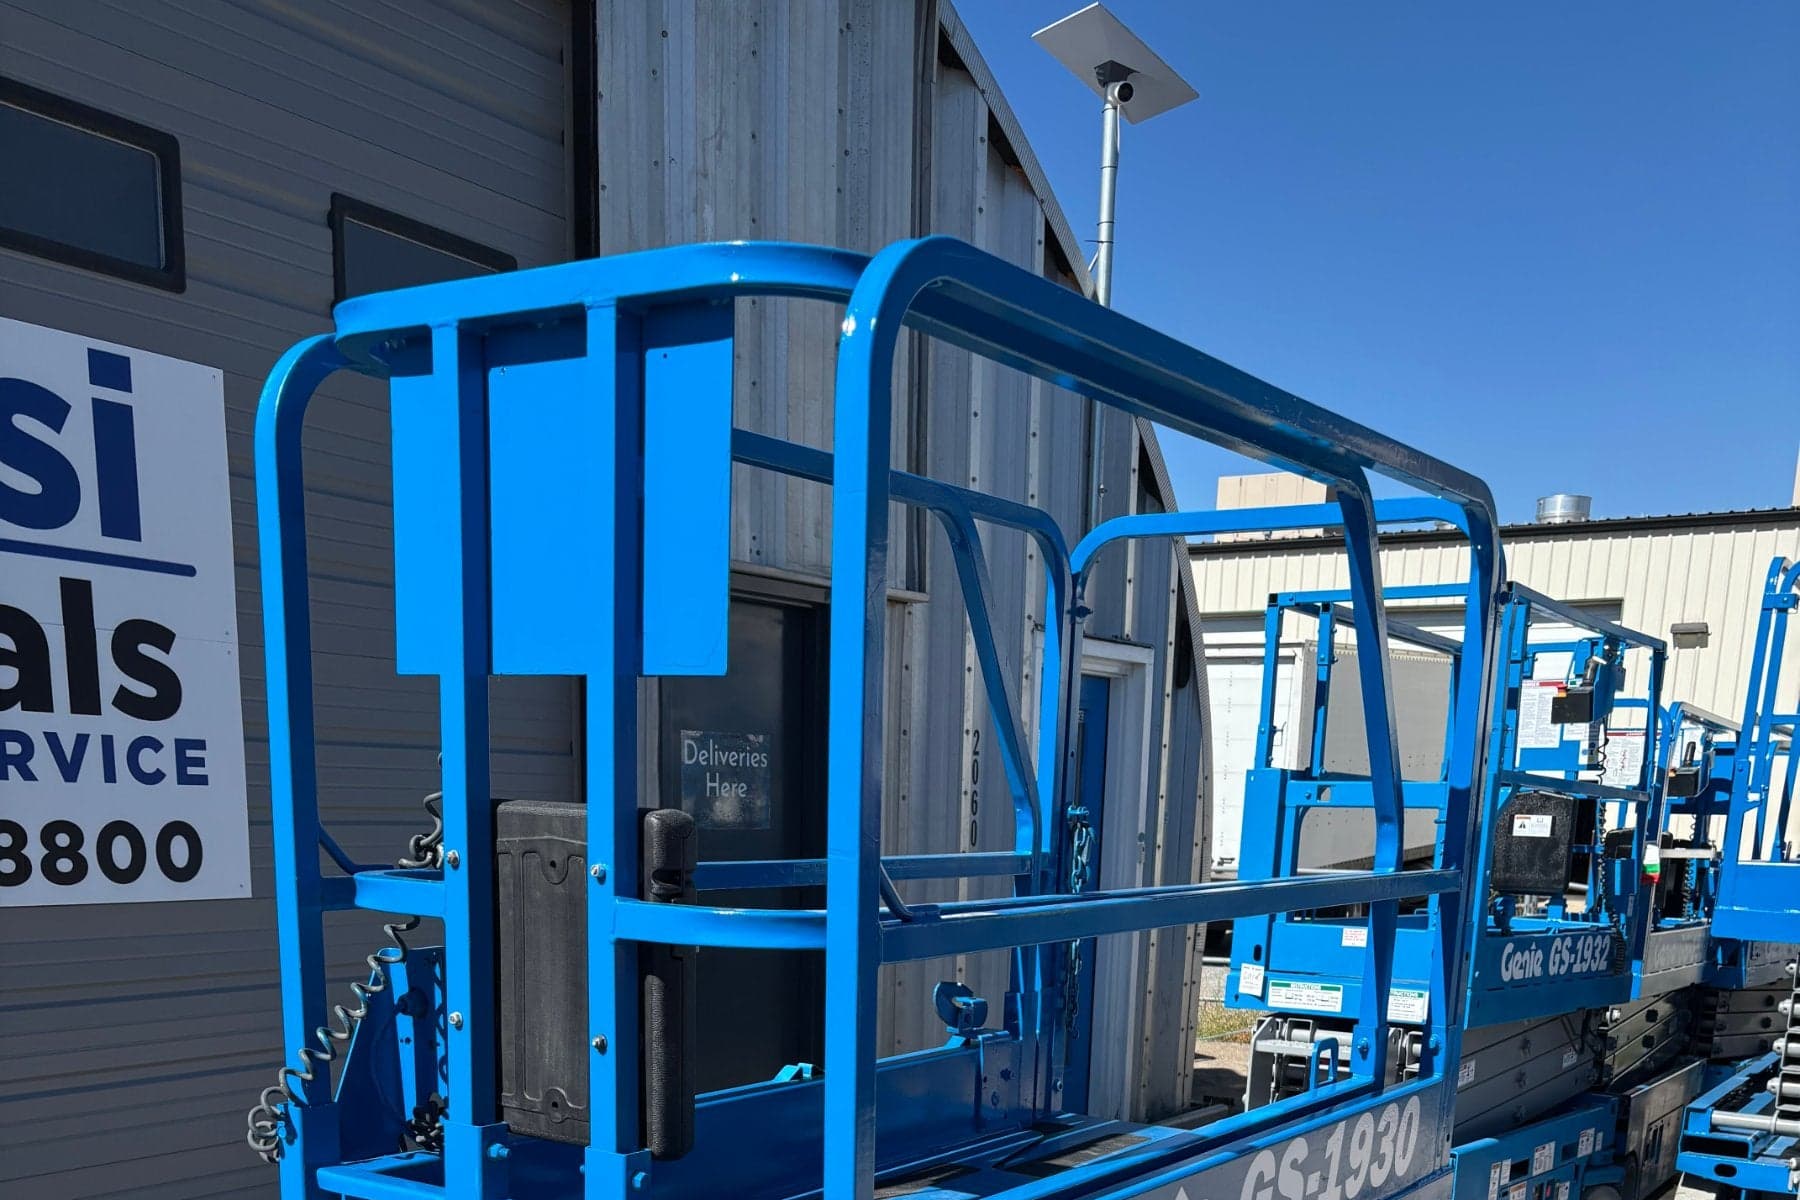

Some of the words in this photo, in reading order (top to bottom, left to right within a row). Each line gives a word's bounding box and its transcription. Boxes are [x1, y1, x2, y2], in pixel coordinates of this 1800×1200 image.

[0, 347, 142, 542] si
[684, 738, 768, 768] Deliveries
[706, 771, 748, 798] Here
[970, 728, 981, 848] 2060
[1501, 941, 1544, 982] Genie
[1548, 934, 1611, 976] GS-1932
